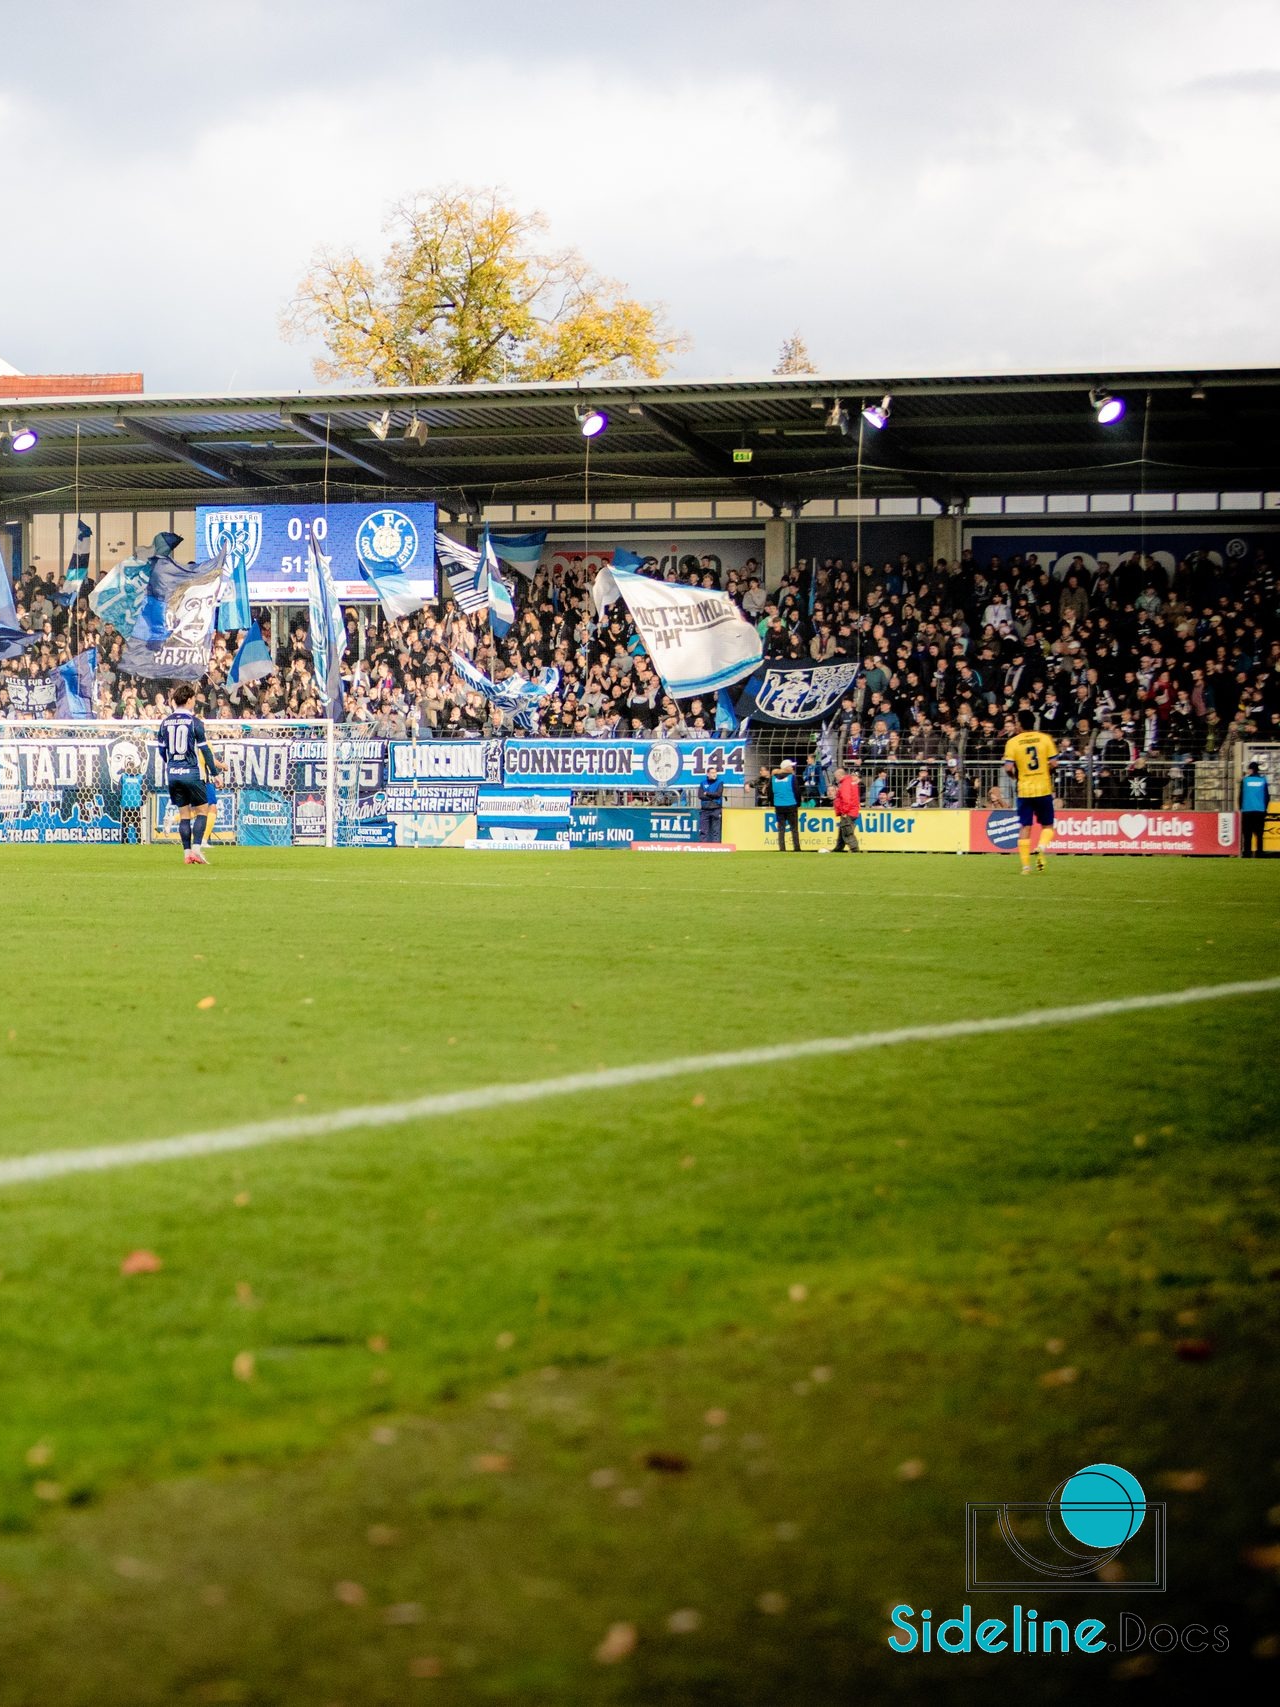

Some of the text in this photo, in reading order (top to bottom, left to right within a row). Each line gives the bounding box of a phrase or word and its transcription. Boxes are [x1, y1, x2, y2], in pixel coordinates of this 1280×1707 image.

[287, 517, 328, 541] 0:0
[167, 724, 188, 754] 10
[505, 747, 632, 774] CONNECTION
[691, 747, 744, 774] 144
[1025, 746, 1039, 770] 3
[387, 798, 474, 812] ABSCHAFFEN!
[579, 812, 598, 825] wir
[1147, 816, 1194, 837] Liebe
[45, 829, 121, 842] BABELSBER
[588, 829, 605, 841] ins
[607, 829, 634, 841] KINO
